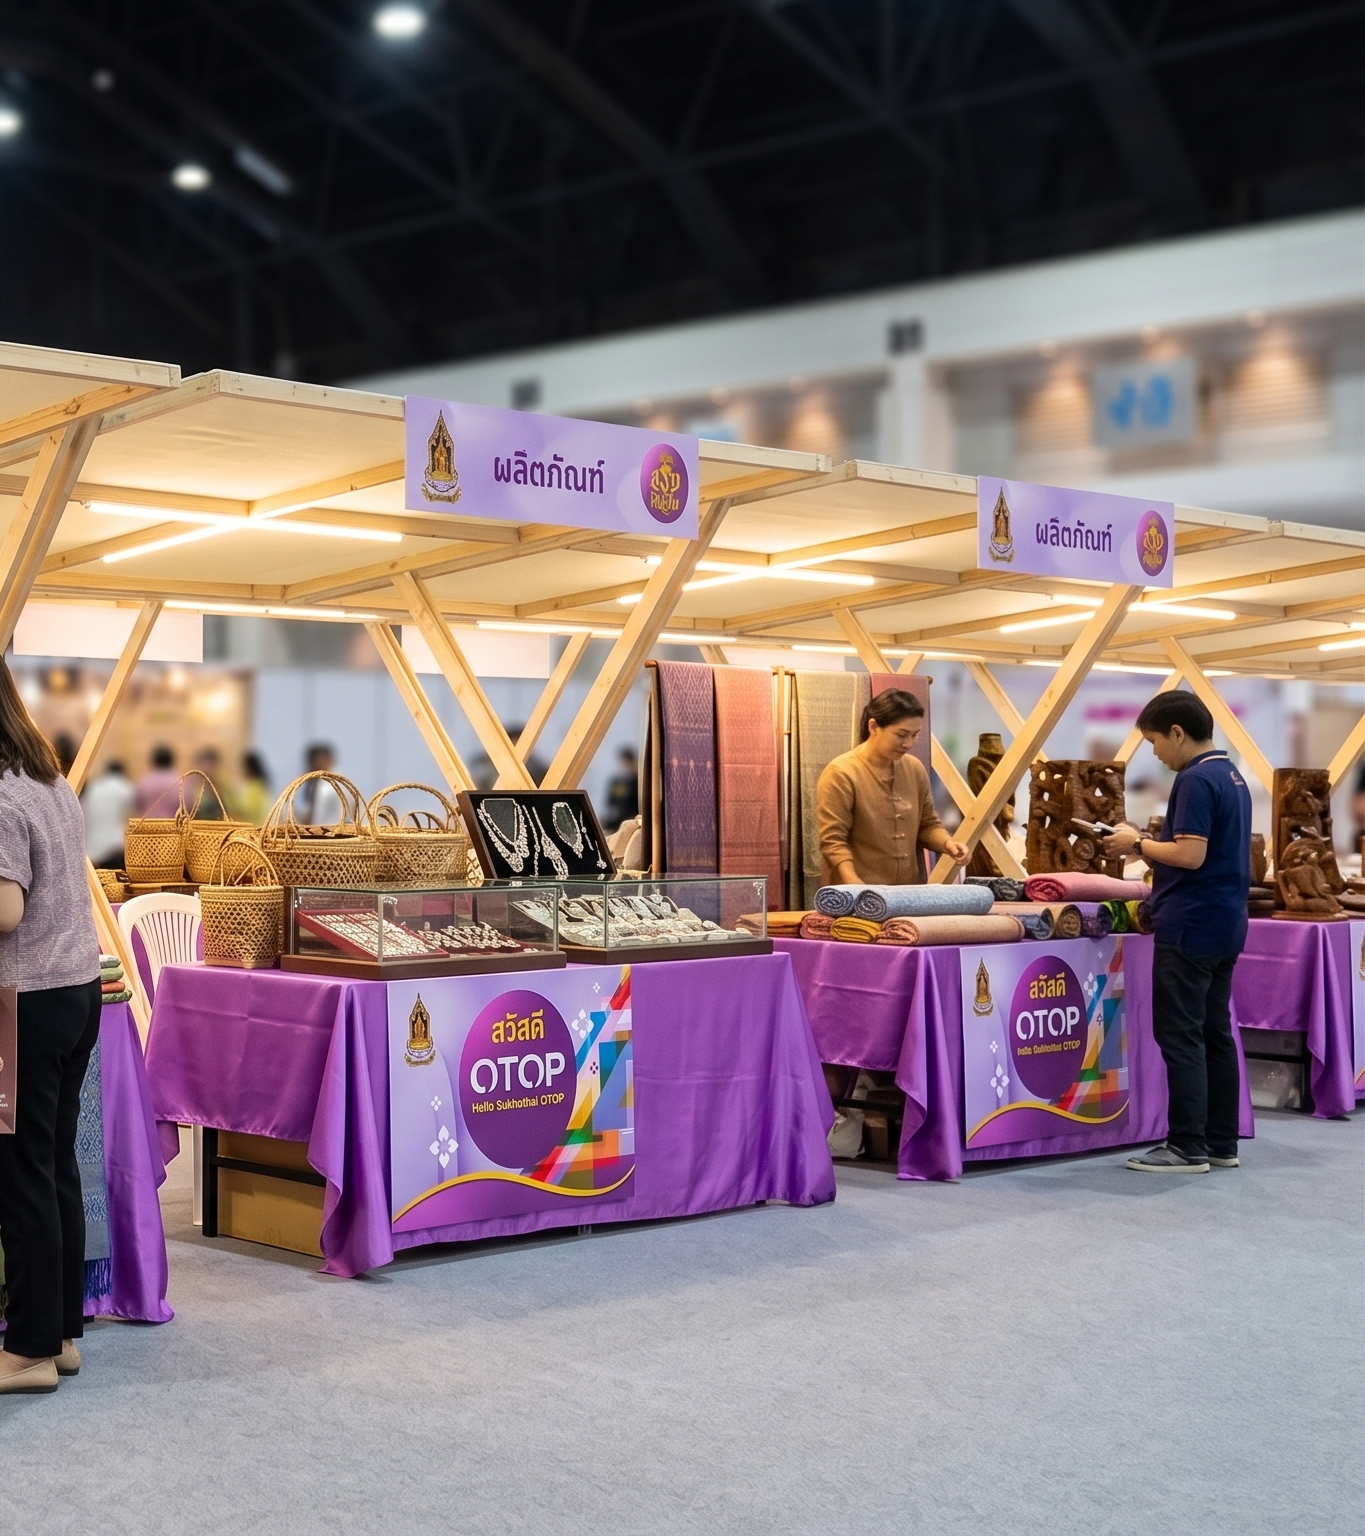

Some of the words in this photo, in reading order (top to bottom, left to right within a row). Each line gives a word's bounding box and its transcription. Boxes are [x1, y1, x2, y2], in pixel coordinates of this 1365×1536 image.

[494, 449, 605, 494] ผลิตภัณฑ์
[1036, 516, 1112, 552] ผลิตภัณฑ์
[1029, 971, 1066, 999] สวัสดี
[491, 1008, 544, 1044] สวัสดี
[1016, 1005, 1080, 1040] OTOP
[470, 1051, 566, 1094] OTOP
[472, 1101, 494, 1113] Hello
[496, 1096, 539, 1111] Sukhothai
[540, 1092, 565, 1105] OTOP
